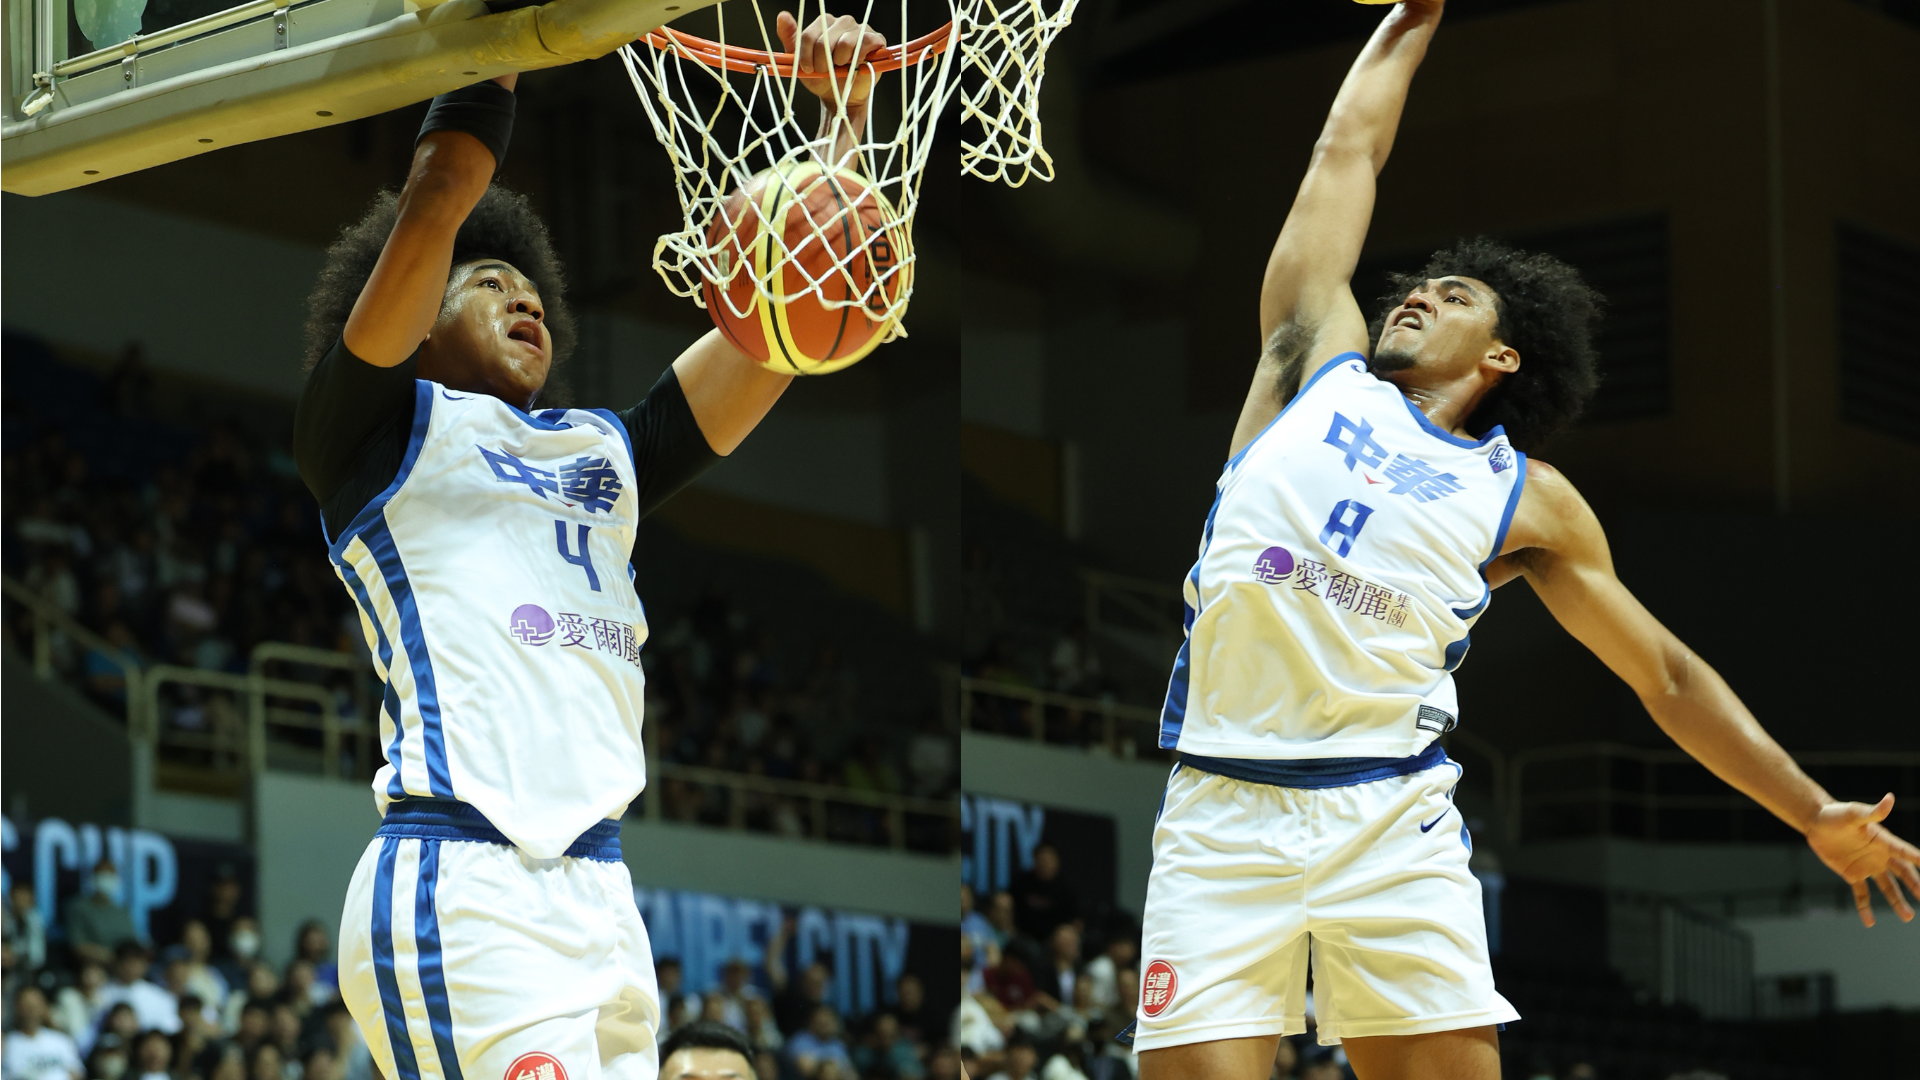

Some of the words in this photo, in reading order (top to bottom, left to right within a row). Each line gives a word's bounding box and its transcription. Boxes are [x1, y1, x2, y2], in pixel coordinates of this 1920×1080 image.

[475, 443, 623, 514] 中華
[1323, 411, 1467, 503] 中華
[555, 519, 602, 592] 4
[1319, 499, 1375, 558] 8
[1292, 558, 1394, 621] 愛爾麗
